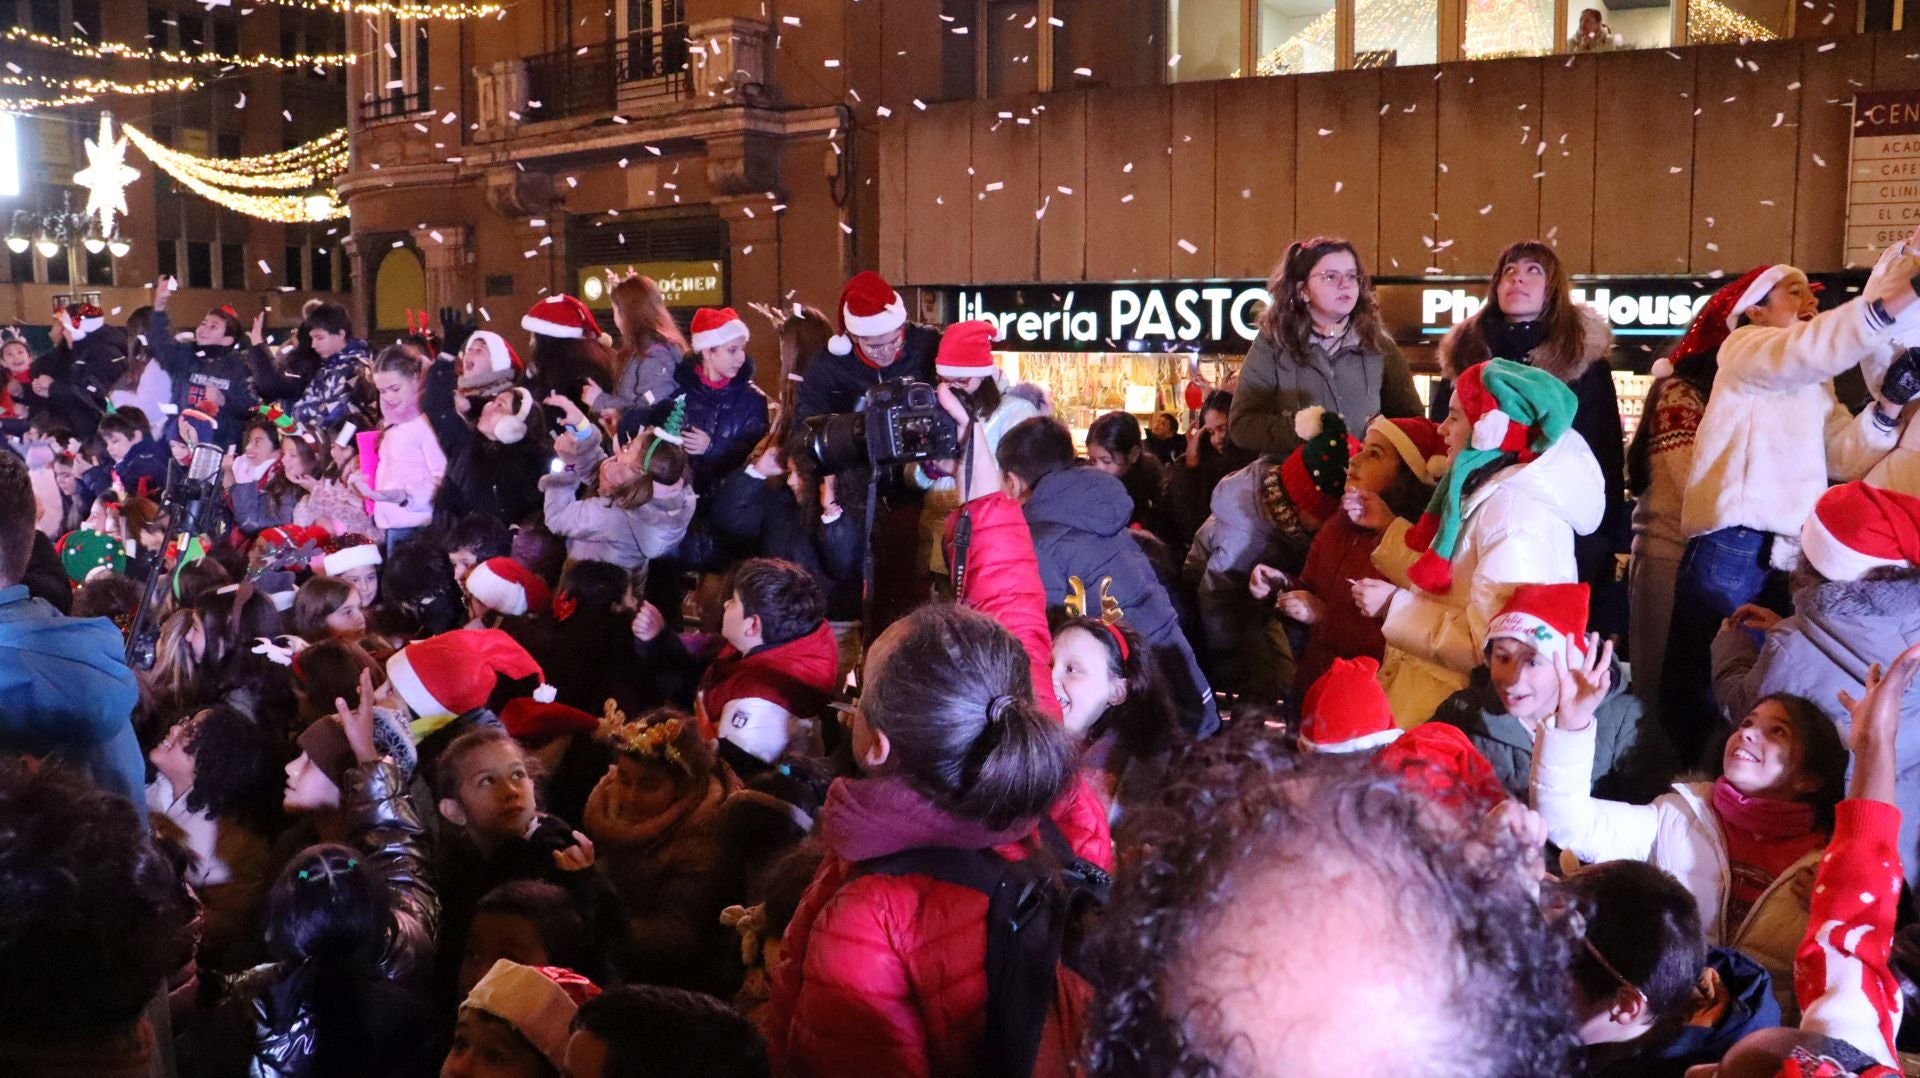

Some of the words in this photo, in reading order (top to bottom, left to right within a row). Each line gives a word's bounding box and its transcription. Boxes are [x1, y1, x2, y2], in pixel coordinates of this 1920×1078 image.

[1870, 104, 1920, 125] CEN
[1882, 141, 1920, 153] ACAD
[1878, 209, 1892, 220] EL
[1902, 208, 1920, 220] CA
[959, 291, 1097, 341] librería
